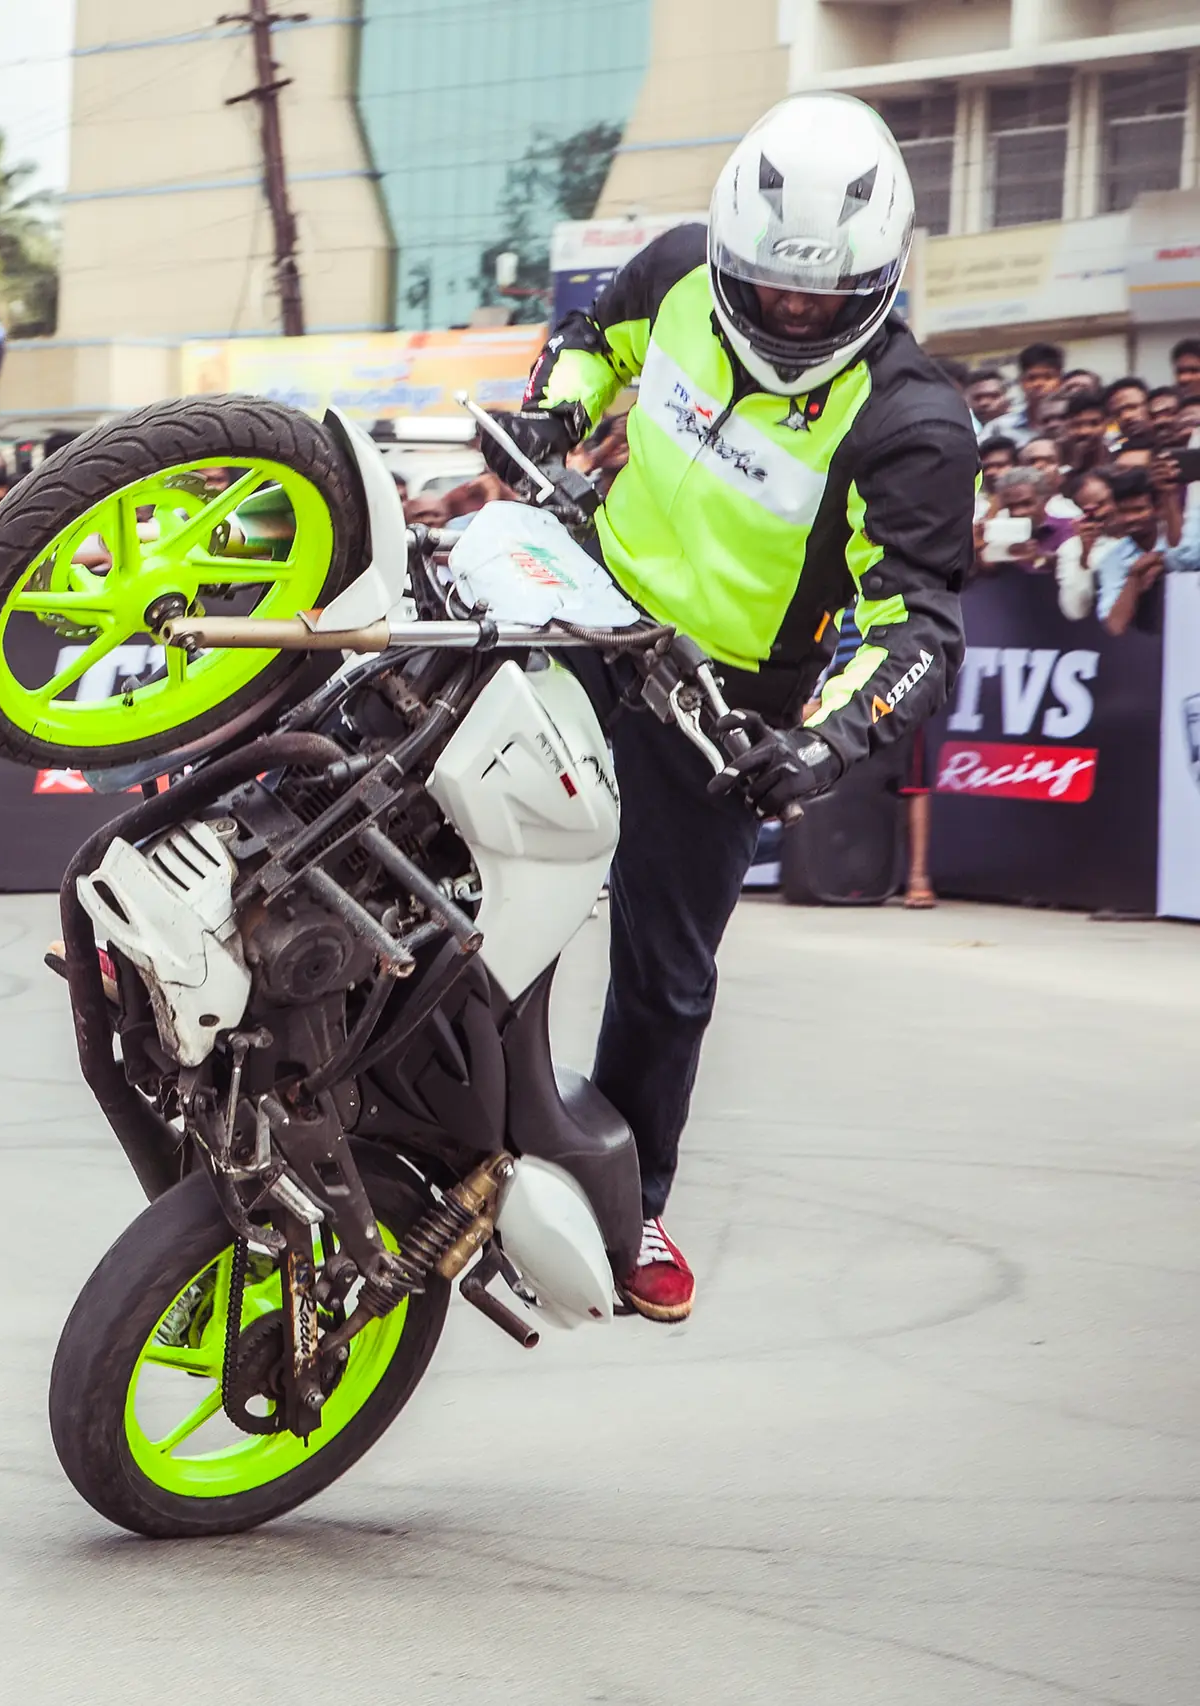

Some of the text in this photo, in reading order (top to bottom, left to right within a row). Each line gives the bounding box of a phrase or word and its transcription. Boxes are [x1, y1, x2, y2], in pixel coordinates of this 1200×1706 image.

[946, 646, 1100, 738] TVS
[936, 750, 1095, 797] Racing
[298, 1291, 318, 1358] Racin
